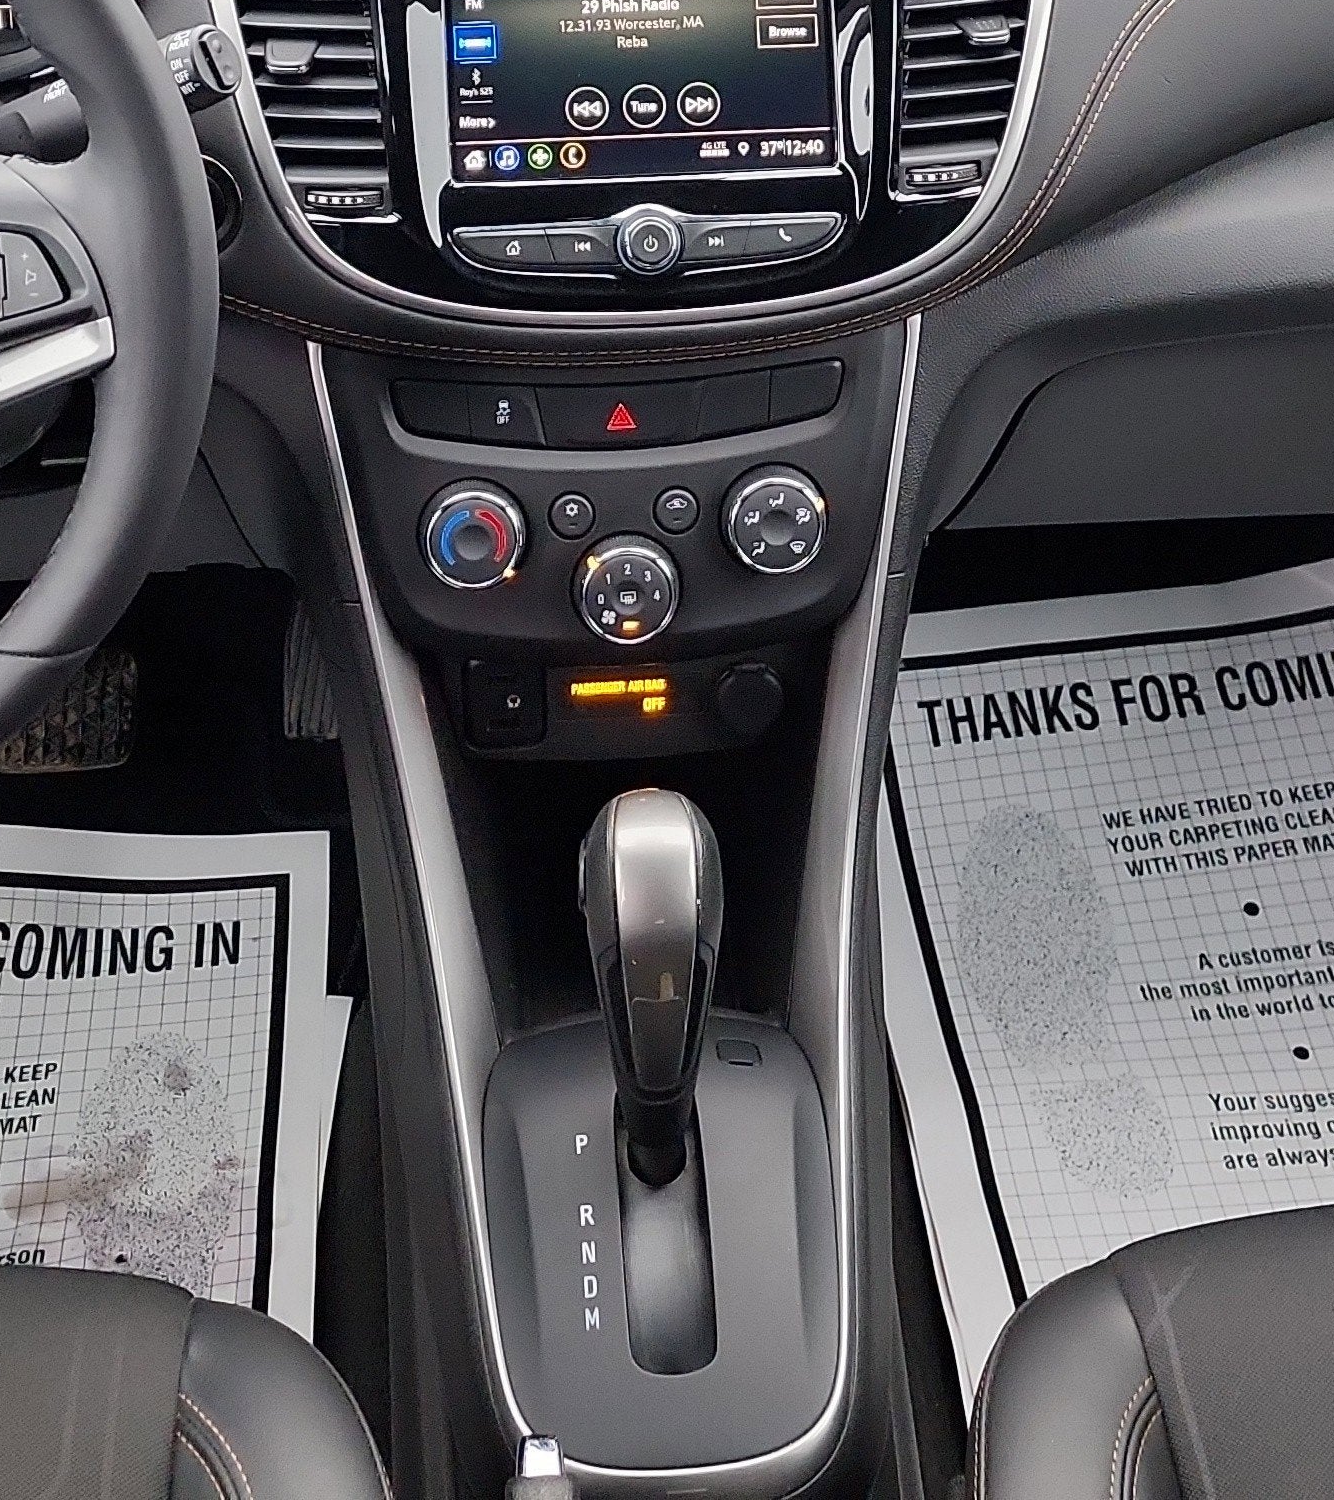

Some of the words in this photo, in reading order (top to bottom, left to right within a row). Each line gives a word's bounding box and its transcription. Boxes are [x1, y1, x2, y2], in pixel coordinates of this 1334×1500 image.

[581, 0, 599, 14] 29
[559, 18, 611, 33] 12.31.93
[613, 16, 680, 31] Worcester,
[683, 15, 704, 28] MA
[768, 25, 807, 39] Browse
[617, 35, 648, 49] Reba
[170, 58, 183, 71] ON
[174, 70, 189, 83] OFF
[630, 100, 658, 113] Tune
[459, 116, 487, 129] More
[701, 142, 713, 150] 4G
[714, 141, 727, 149] LTE
[785, 139, 824, 156] 12:40
[496, 415, 510, 425] OFF
[624, 563, 632, 575] 2
[644, 570, 652, 582] 3
[606, 574, 611, 584] 1
[597, 594, 605, 605] 0
[653, 589, 661, 601] 4
[571, 681, 625, 696] PASSENGER
[628, 680, 644, 692] AIR
[645, 678, 666, 691] BAG
[642, 697, 666, 712] OFF
[918, 681, 1100, 748] THANKS
[1111, 670, 1205, 726] FOR
[1102, 810, 1136, 830] WE
[1140, 802, 1191, 827] HAVE
[1194, 794, 1253, 819] TRIED
[1256, 788, 1283, 809] TO
[1107, 831, 1164, 855] YOUR
[1168, 814, 1280, 849] CARPETING
[1124, 855, 1181, 879] WITH
[1184, 847, 1229, 871] THIS
[1233, 839, 1299, 865] PAPER
[194, 920, 241, 968] IN
[1198, 952, 1214, 970] A
[1218, 945, 1312, 968] customer
[1140, 983, 1173, 1002] the
[1179, 978, 1229, 999] most
[1191, 1004, 1212, 1023] in
[1216, 1001, 1250, 1020] the
[1255, 995, 1315, 1017] world
[3, 1062, 58, 1084] KEEP
[1208, 1091, 1257, 1113] Your
[1210, 1120, 1322, 1143] improving
[575, 1134, 588, 1155] P
[1222, 1152, 1259, 1170] are
[579, 1204, 595, 1226] R
[581, 1241, 596, 1264] N
[583, 1275, 598, 1299] D
[585, 1306, 600, 1331] M
